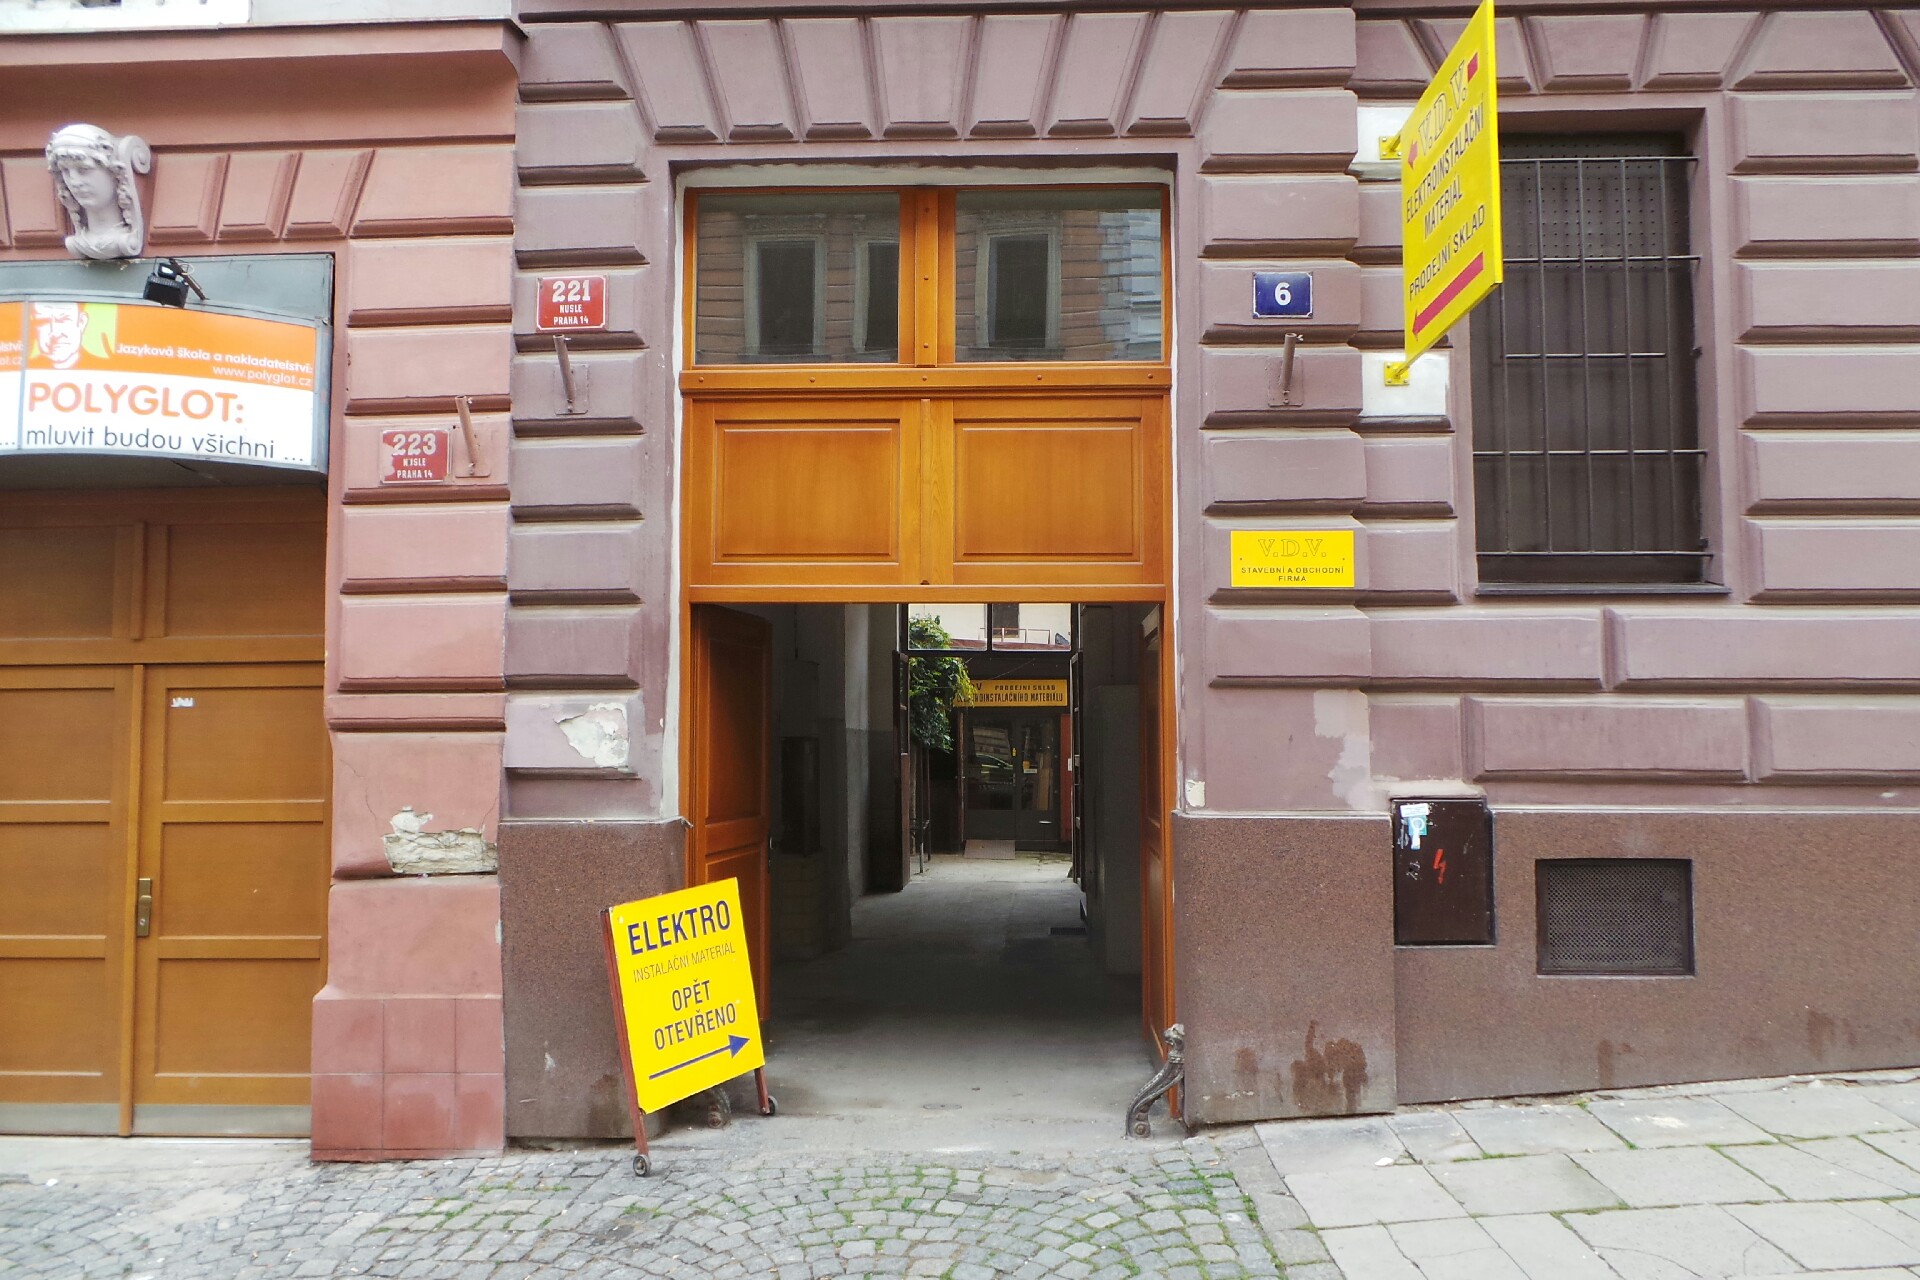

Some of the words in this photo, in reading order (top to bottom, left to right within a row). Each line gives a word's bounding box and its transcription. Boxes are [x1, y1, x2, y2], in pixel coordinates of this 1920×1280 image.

[1406, 93, 1485, 223] ELEKTROINSTALAČNÍ
[1424, 174, 1464, 240] MATERIÁL
[1409, 232, 1452, 301] PRODEJNÍ
[1453, 205, 1485, 254] SKLAD
[552, 279, 591, 302] 221
[1274, 282, 1291, 306] 6
[553, 316, 579, 325] PRAHA
[579, 315, 589, 324] 14
[559, 304, 583, 314] NUSLE
[116, 343, 174, 358] Jazyková
[177, 345, 210, 361] škola
[214, 353, 222, 362] a
[225, 354, 313, 374] nakladatelství:
[213, 365, 312, 387] www.polyglot.cz
[28, 382, 244, 424] POLYGLOT:
[26, 424, 94, 446] mluvit
[104, 426, 182, 450] budou
[191, 433, 274, 459] všichni
[392, 433, 437, 456] 223
[396, 469, 422, 479] PRAHA
[423, 469, 433, 478] 14
[1258, 538, 1327, 558] V.D.V.
[1241, 566, 1285, 574] STAVEBNÍ
[1295, 566, 1344, 574] OBCHODNÍ
[627, 900, 731, 956] ELEKTRO
[633, 952, 691, 983] INSTALAČNÍ
[691, 940, 736, 964] MATERIÁL
[672, 978, 711, 1012] OPĚT
[654, 1002, 737, 1051] OTEVŘENO
